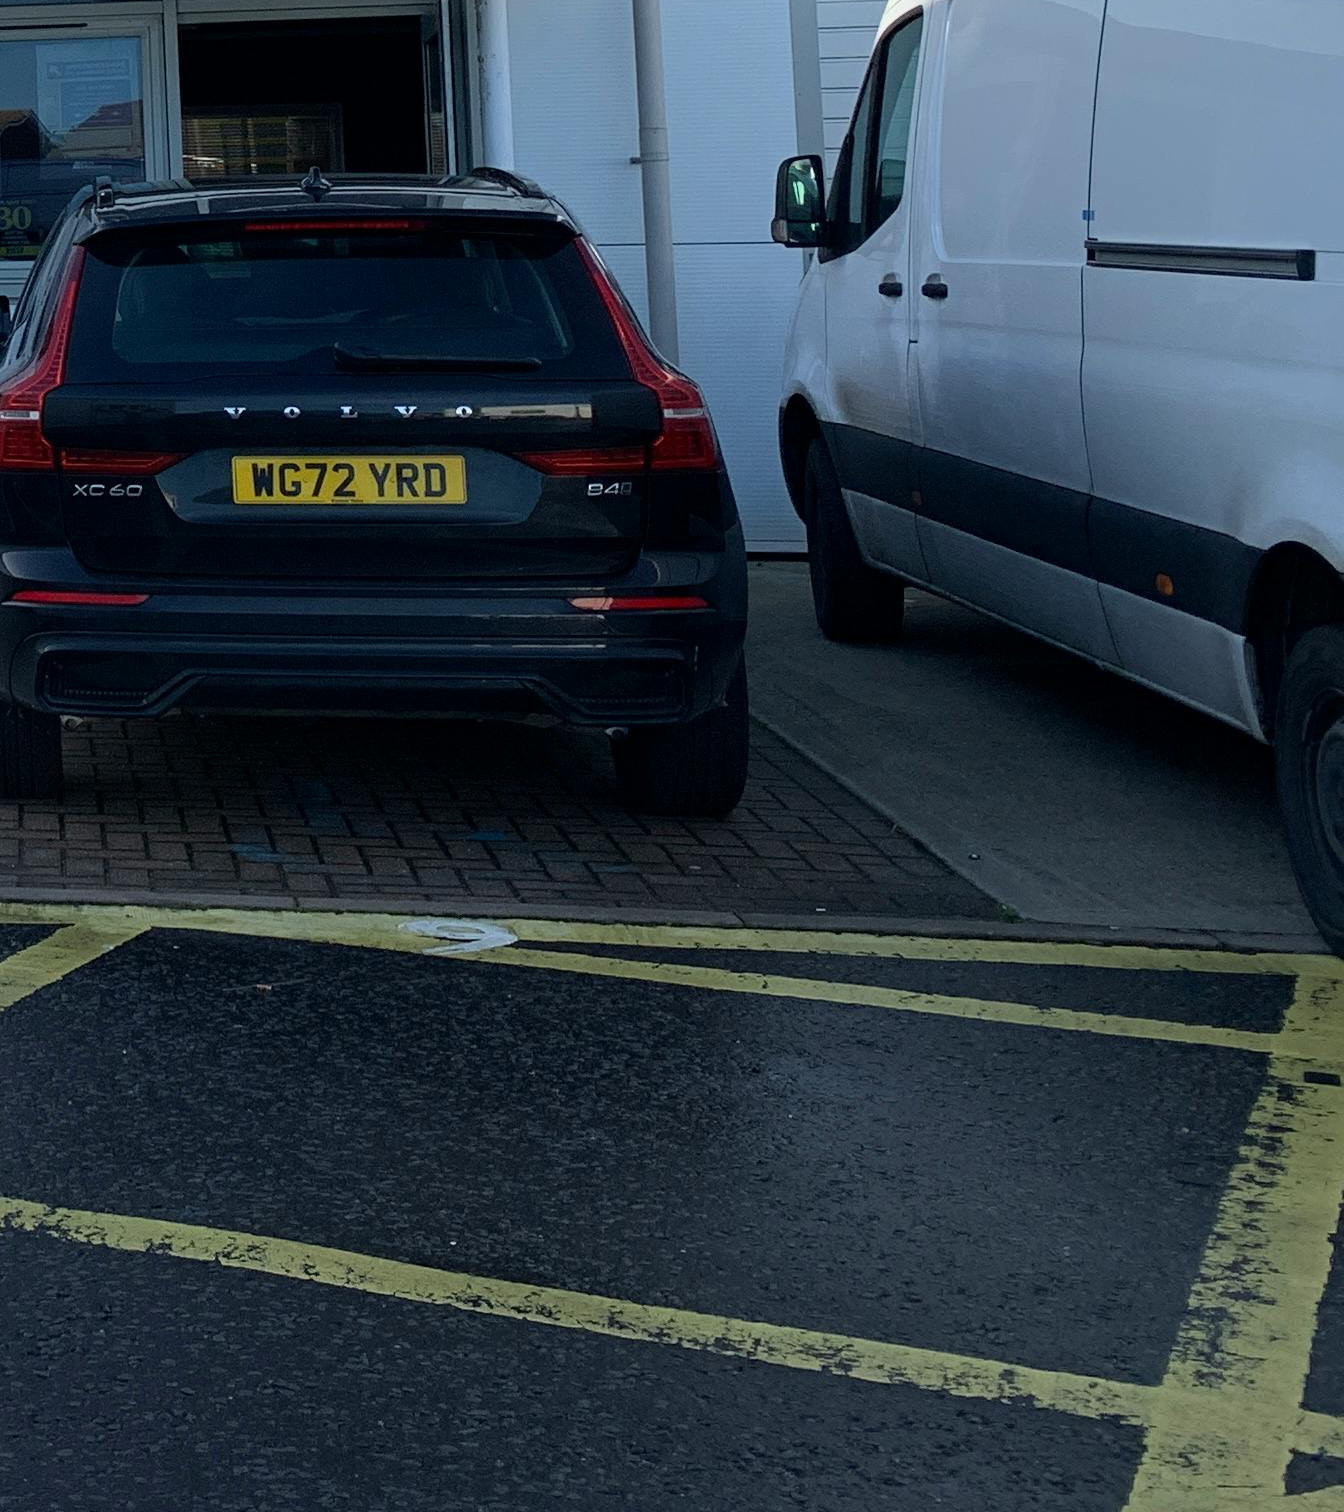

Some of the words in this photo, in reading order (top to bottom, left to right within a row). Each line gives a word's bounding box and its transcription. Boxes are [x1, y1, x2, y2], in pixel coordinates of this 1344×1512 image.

[224, 405, 473, 420] VOLVO
[251, 463, 356, 497] WG72
[369, 462, 447, 497] YRD
